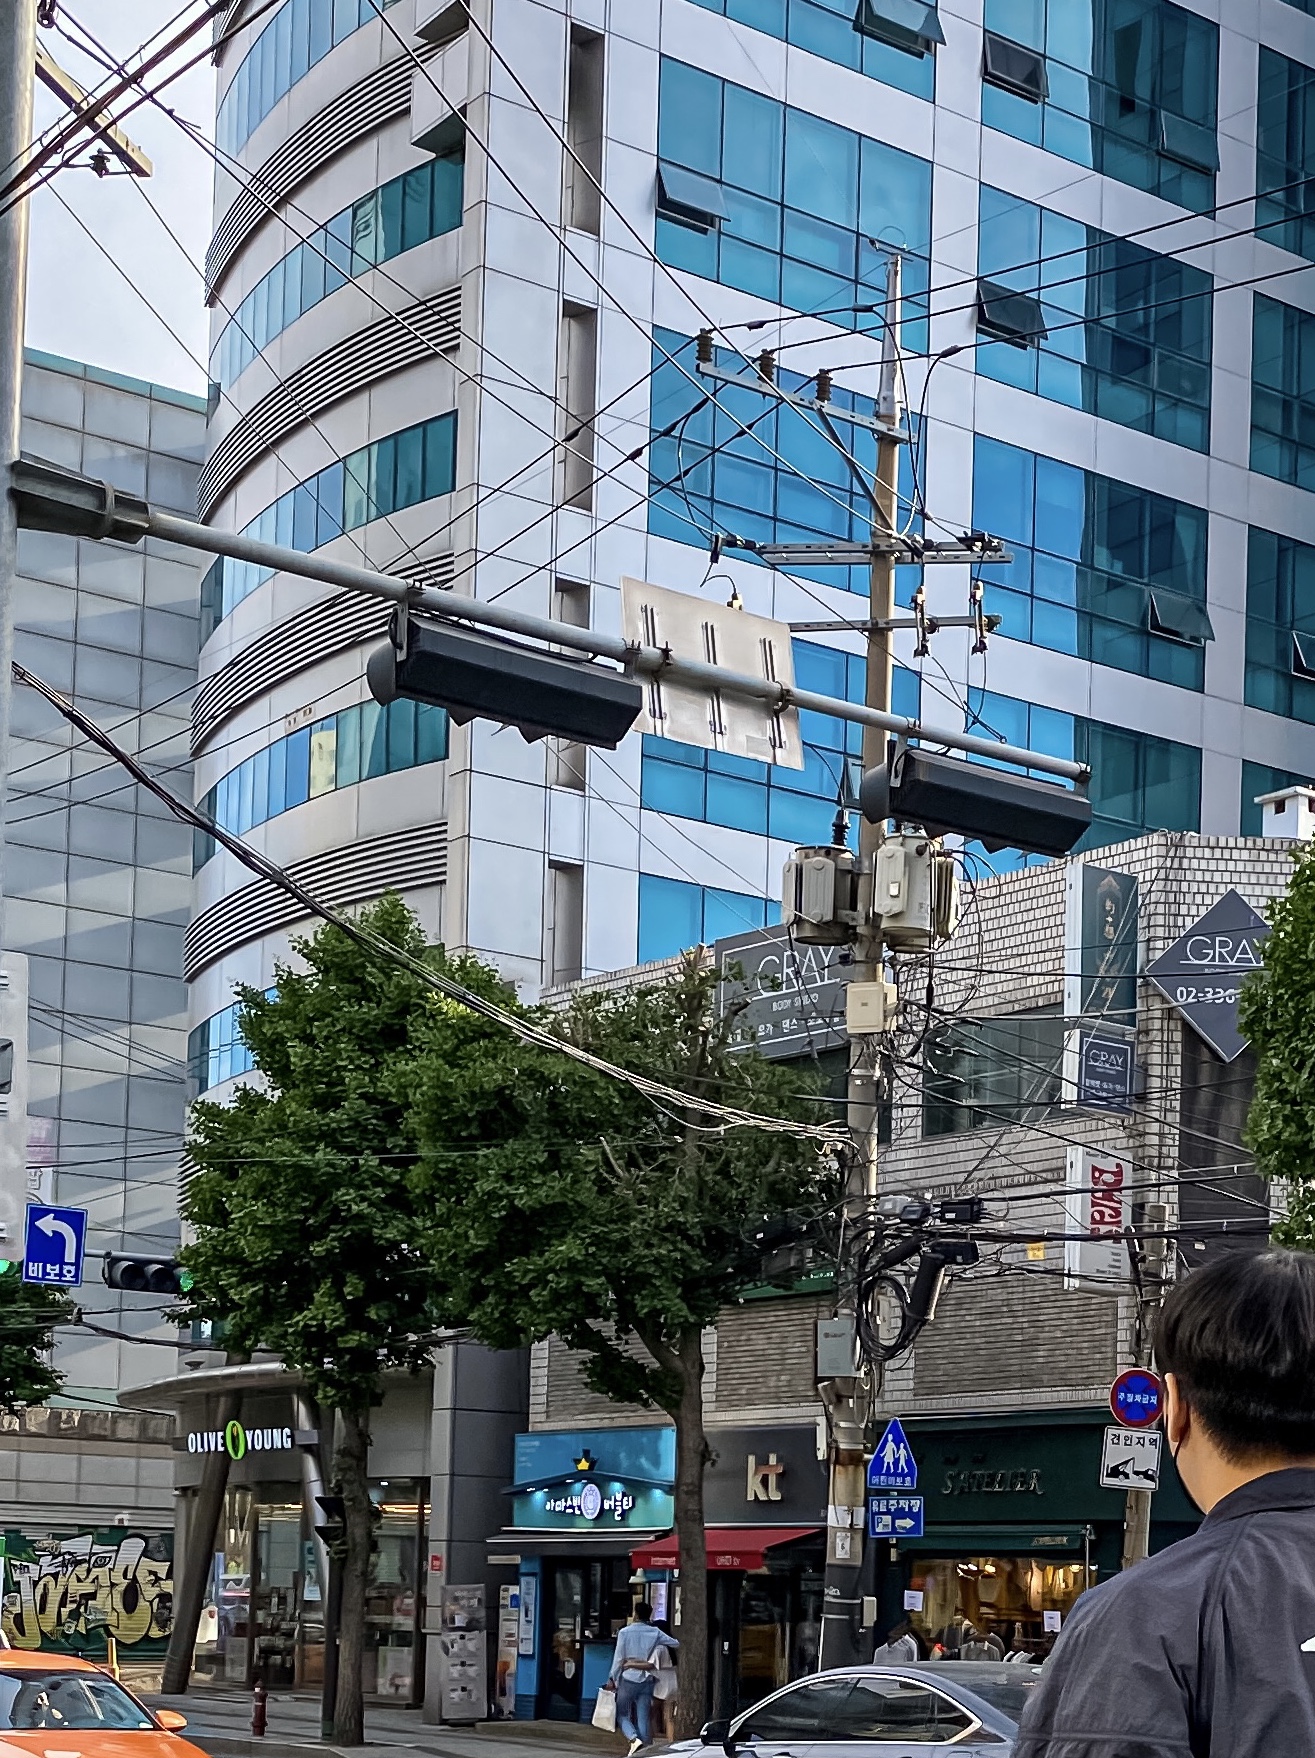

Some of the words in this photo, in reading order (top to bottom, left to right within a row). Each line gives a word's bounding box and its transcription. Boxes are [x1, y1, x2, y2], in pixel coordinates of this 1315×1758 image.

[28, 1261, 76, 1281] 비보호
[187, 1431, 225, 1453] OLIVE
[245, 1427, 292, 1451] YOUNG
[1110, 1433, 1158, 1450] 견인지역
[747, 1453, 784, 1501] kt
